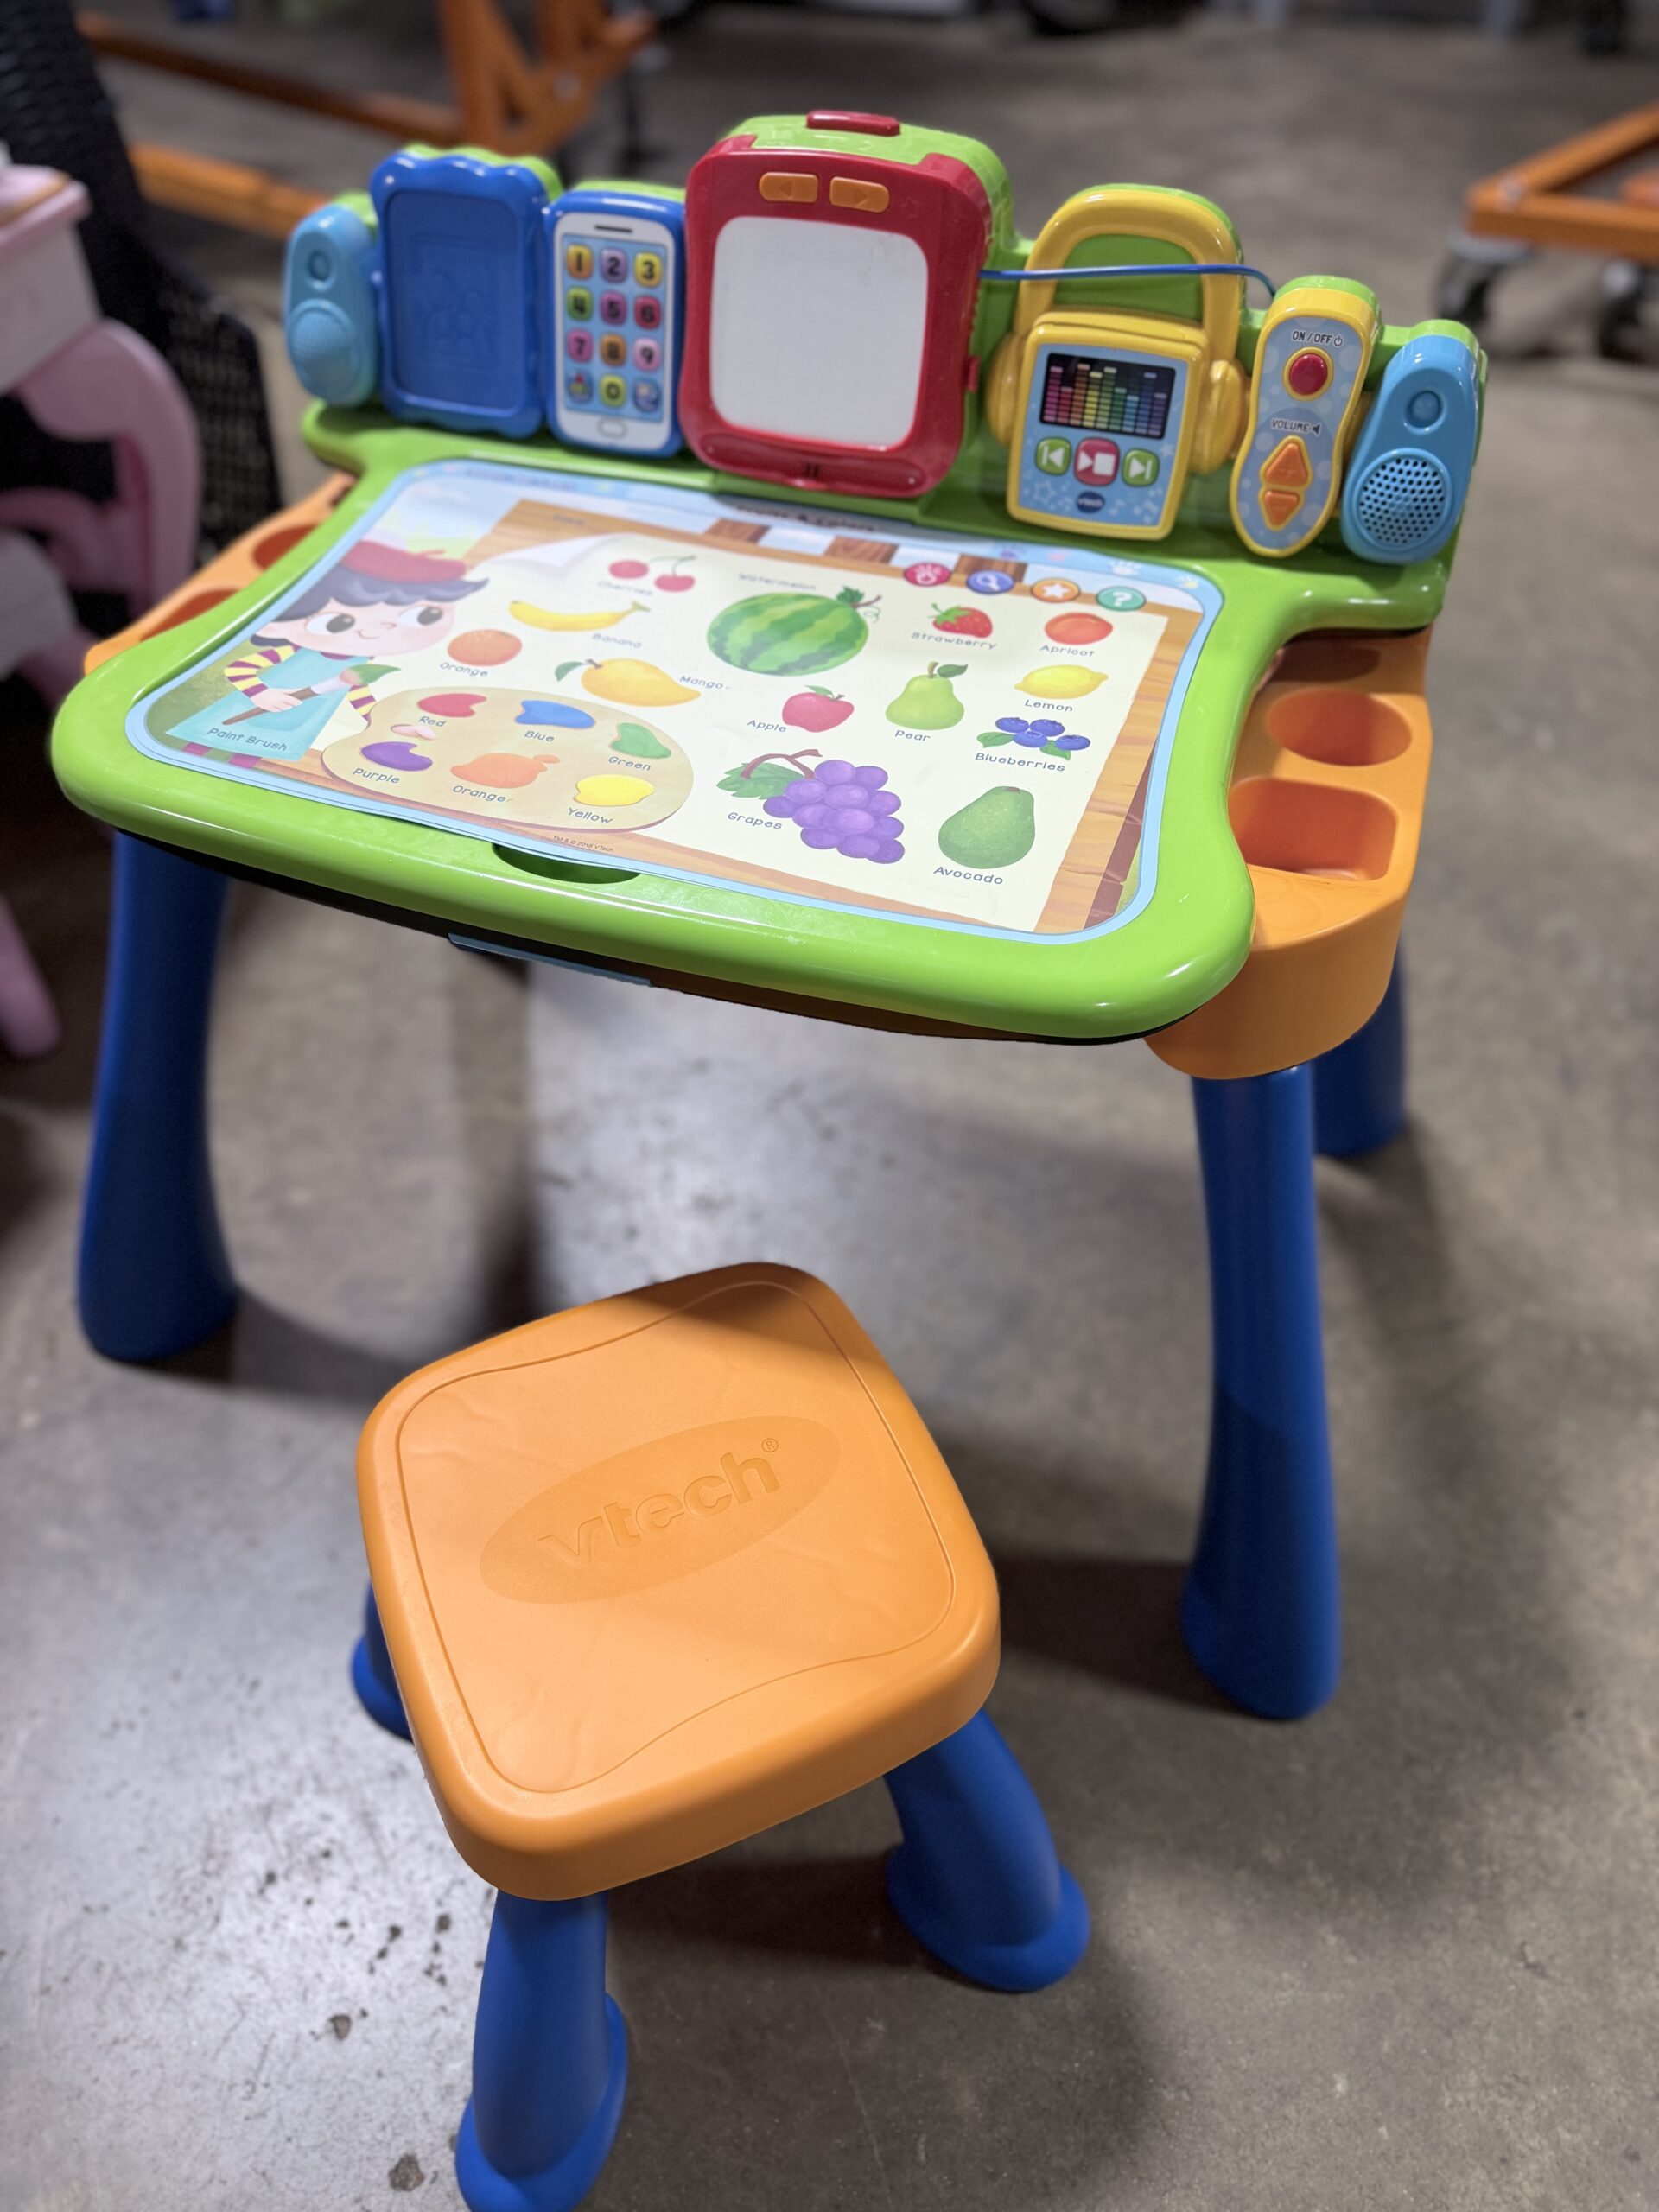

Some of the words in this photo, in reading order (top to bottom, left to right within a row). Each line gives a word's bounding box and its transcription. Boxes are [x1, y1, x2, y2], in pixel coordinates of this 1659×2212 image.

[607, 256, 620, 276] 2
[643, 260, 654, 280] 3
[573, 296, 586, 315] 4
[608, 301, 620, 319] 5
[642, 305, 654, 323] 6
[1292, 331, 1306, 340] ON
[1313, 334, 1332, 344] OFF
[575, 337, 586, 355] 7
[641, 346, 653, 365] 9
[1272, 419, 1309, 433] VOLUME
[592, 633, 642, 649] Banana
[912, 631, 997, 650] Strawberry
[1040, 644, 1095, 657] Apricot
[440, 663, 488, 677] Orange
[679, 675, 724, 690] Mango
[1025, 699, 1073, 713] Lemon
[418, 715, 447, 728] Red
[747, 719, 787, 734] Apple
[207, 727, 245, 741] Paint
[245, 735, 288, 752] Brush
[524, 730, 554, 743] Blue
[894, 729, 931, 741] Pear
[608, 756, 652, 772] Green
[975, 752, 1065, 772] Blueberries
[352, 767, 400, 784] Purple
[453, 785, 506, 802] Orange
[567, 806, 613, 824] Yellow
[728, 812, 782, 830] Grapes
[933, 866, 1004, 886] Avocado
